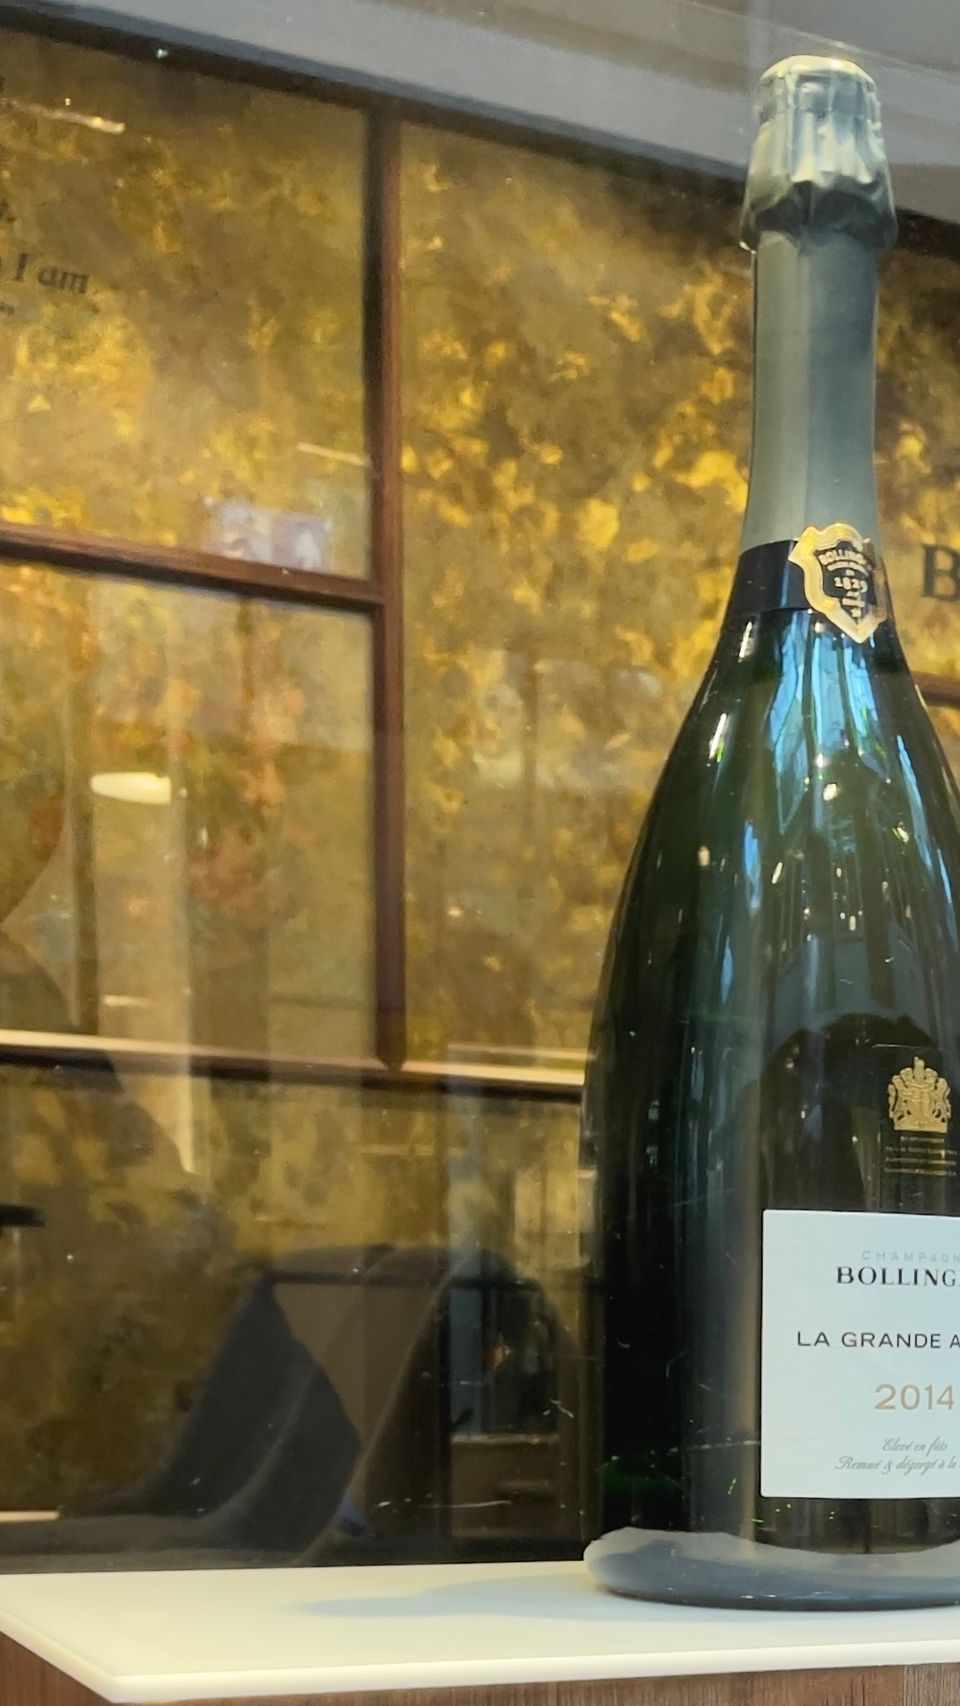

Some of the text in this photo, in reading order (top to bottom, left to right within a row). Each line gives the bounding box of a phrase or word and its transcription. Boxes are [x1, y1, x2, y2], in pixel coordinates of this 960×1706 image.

[36, 265, 90, 294] am
[797, 1331, 831, 1347] LA
[841, 1331, 942, 1349] GRANDE
[874, 1384, 955, 1411] 2014
